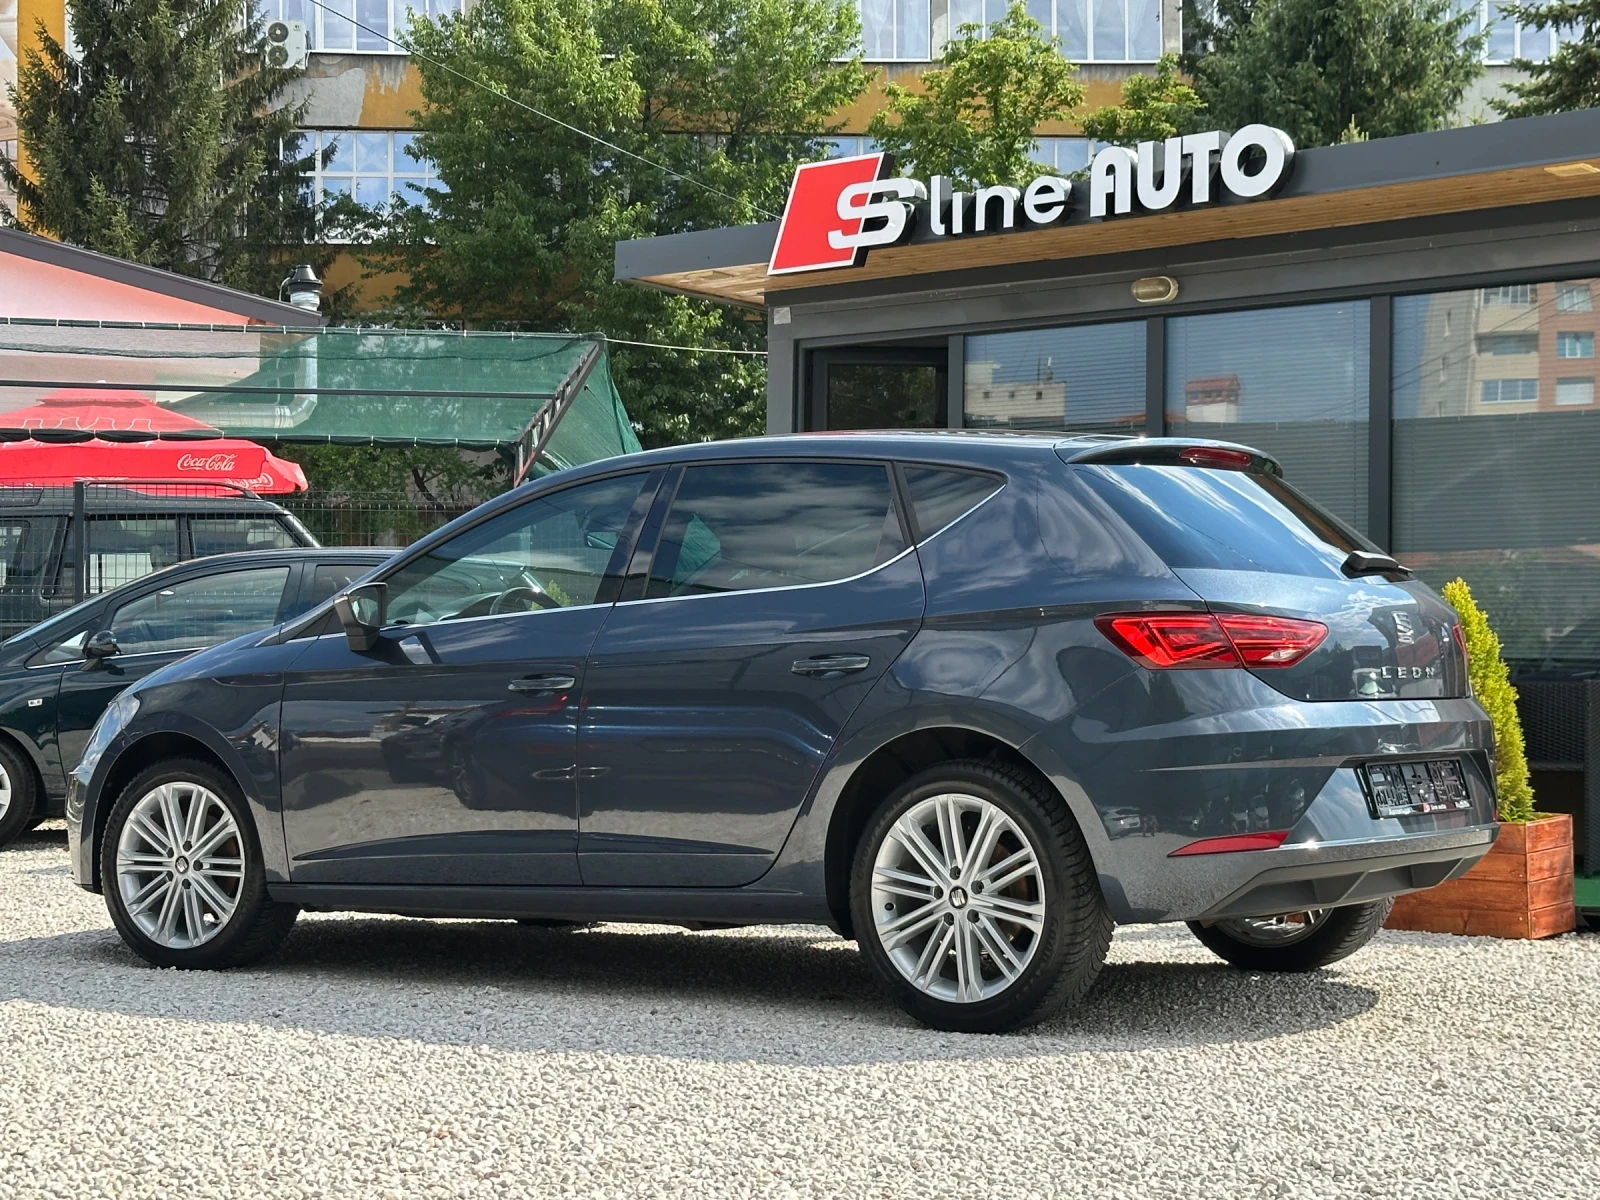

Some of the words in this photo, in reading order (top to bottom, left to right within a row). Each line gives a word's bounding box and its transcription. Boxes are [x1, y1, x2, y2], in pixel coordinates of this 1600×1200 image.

[827, 177, 925, 250] S
[930, 175, 1070, 236] line
[1090, 123, 1295, 218] AUTO
[176, 453, 237, 472] Coca-Cola
[1381, 666, 1436, 679] LEON
